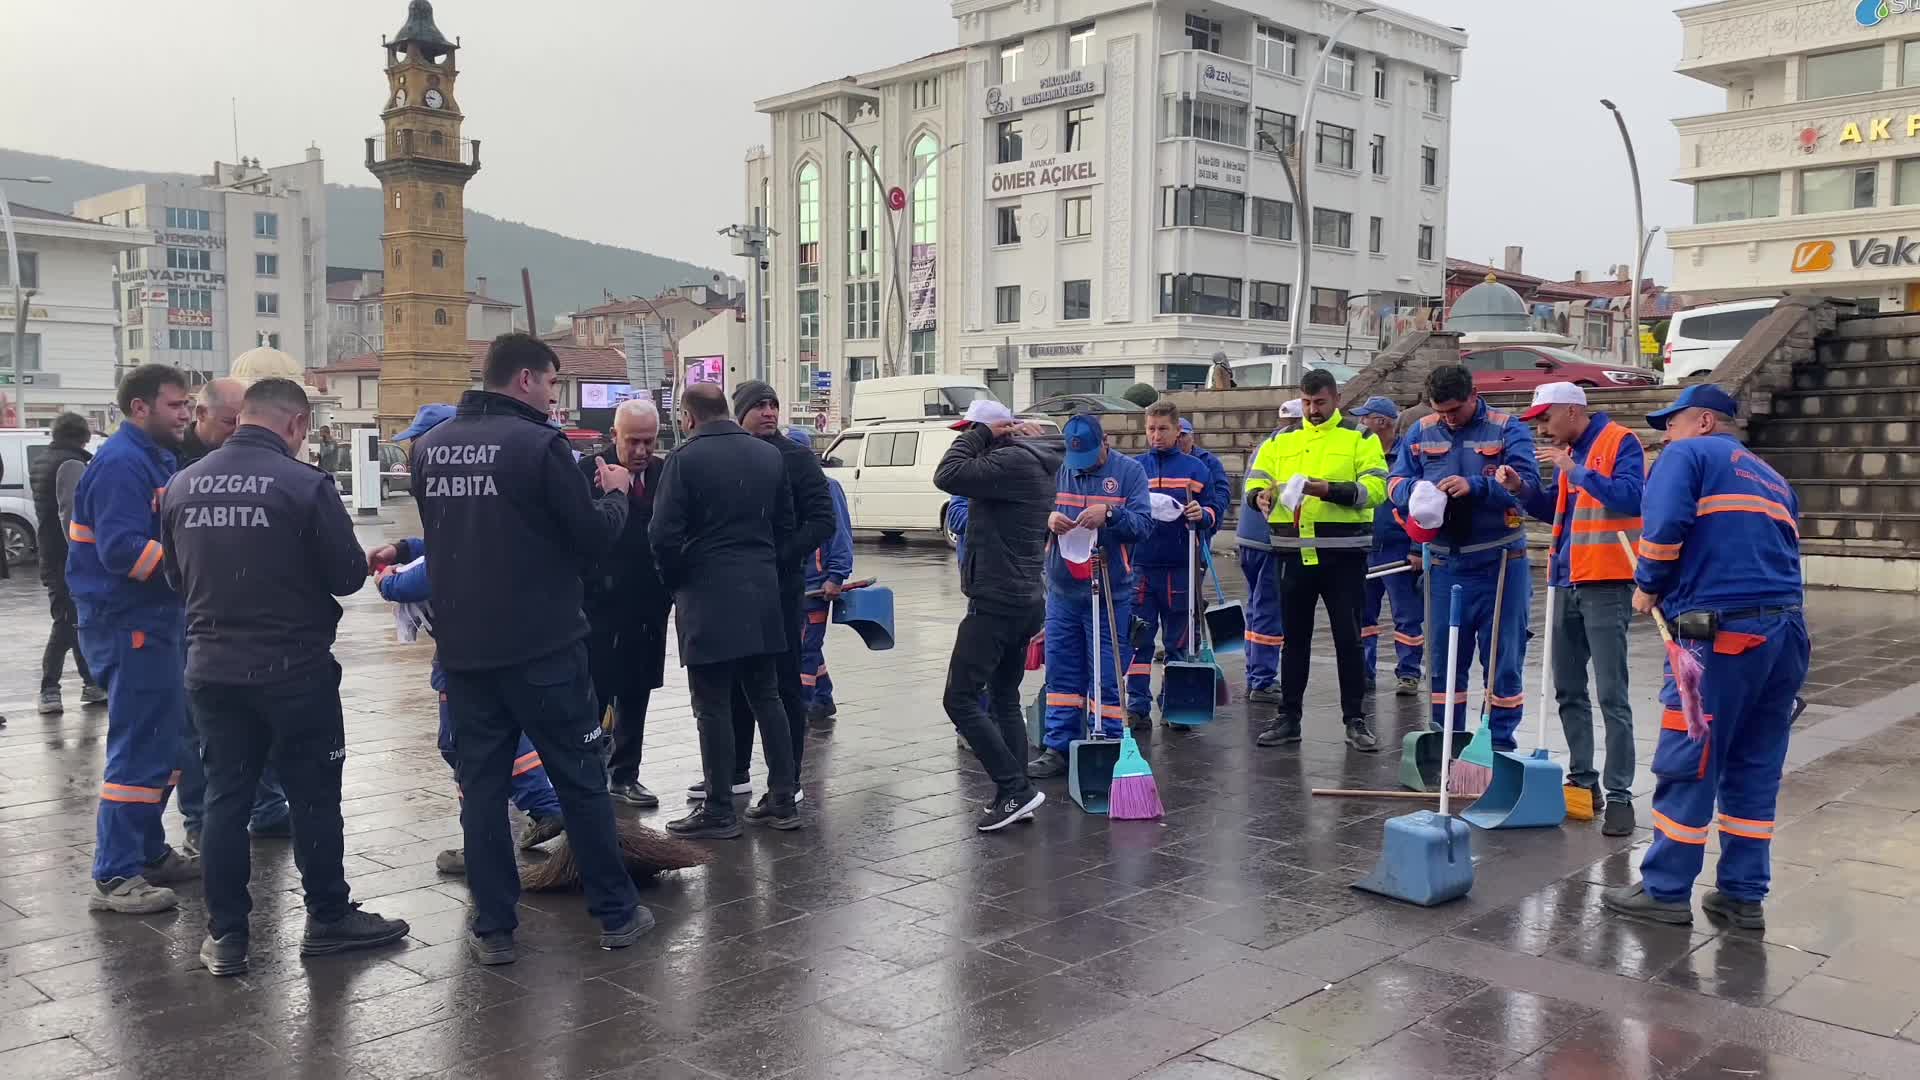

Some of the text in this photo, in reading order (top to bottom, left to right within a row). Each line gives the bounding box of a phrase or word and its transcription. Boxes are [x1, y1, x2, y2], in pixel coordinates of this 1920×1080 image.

[1839, 116, 1892, 145] AK
[1029, 158, 1057, 168] AVUKAT
[991, 161, 1097, 193] ÖMER AÇIKEL
[1848, 235, 1920, 269] Vak
[426, 444, 501, 465] YOZGAT
[187, 474, 275, 495] YOZGAT
[425, 475, 499, 498] ZABITA
[183, 506, 271, 529] ZABITA
